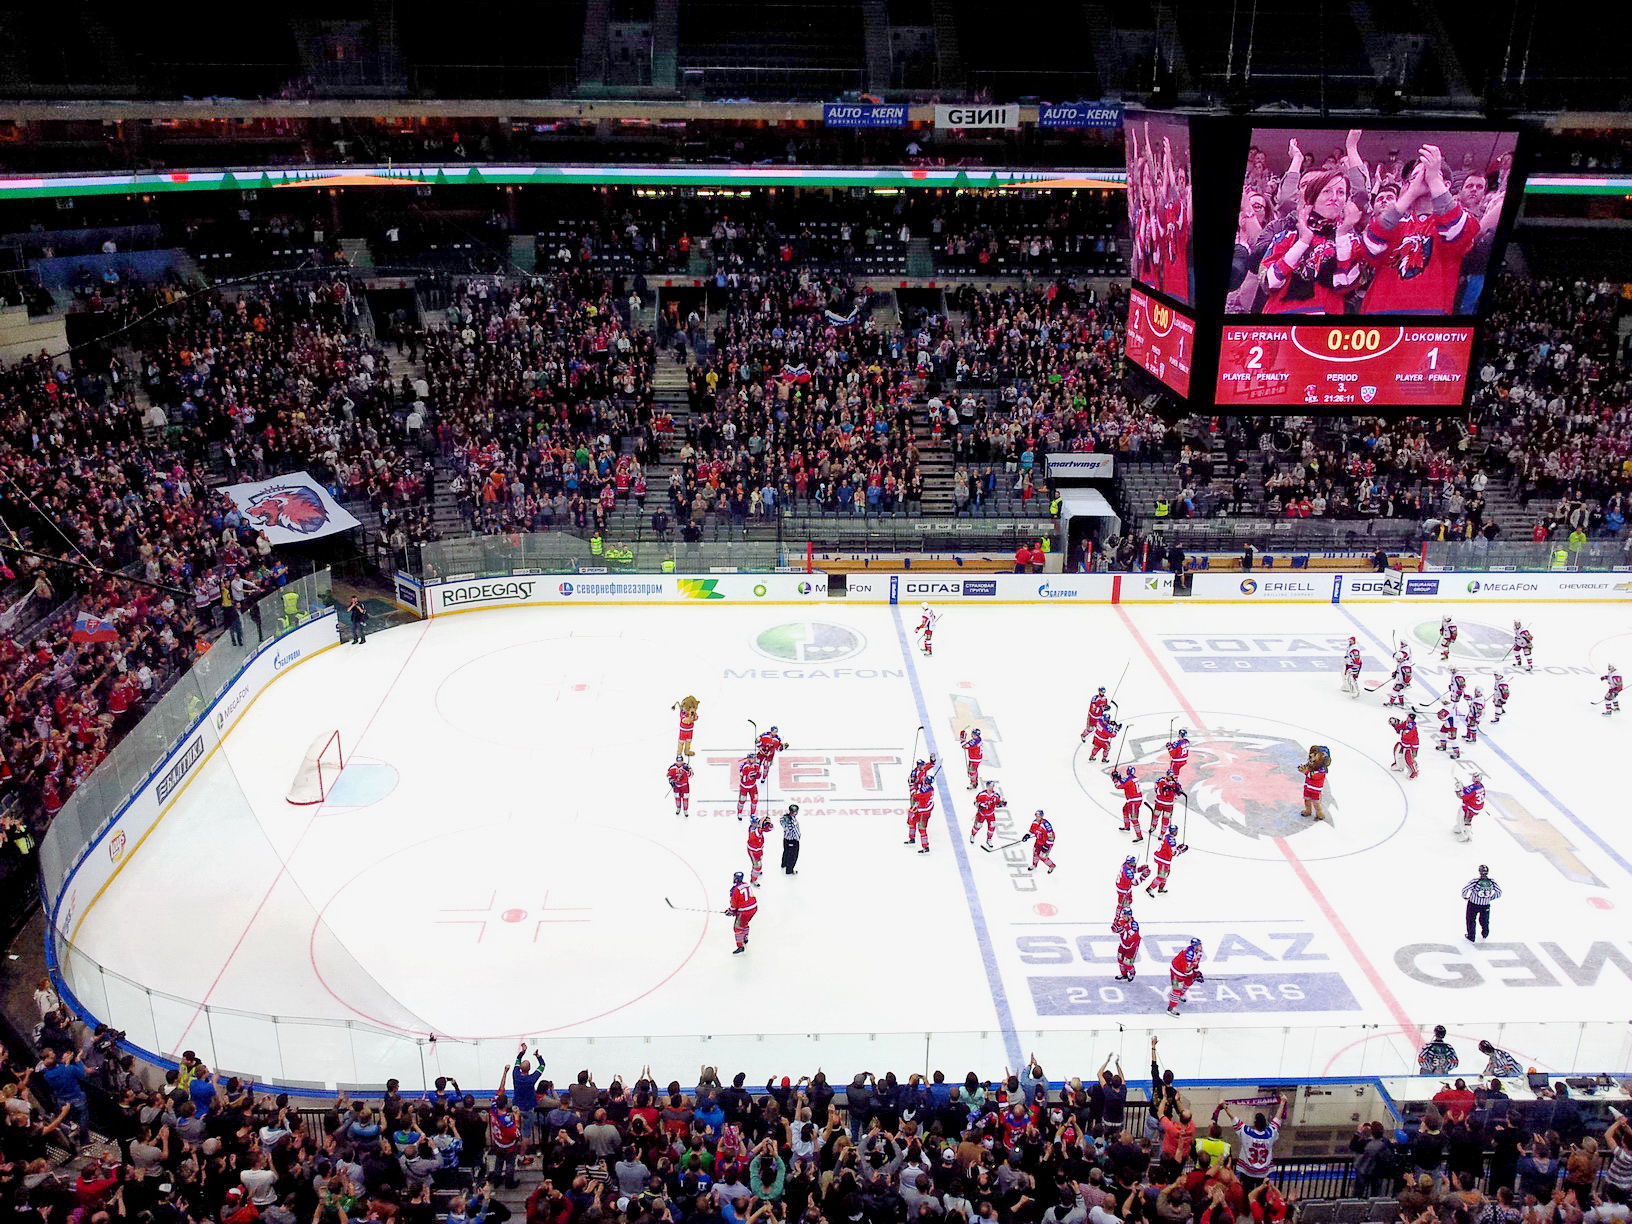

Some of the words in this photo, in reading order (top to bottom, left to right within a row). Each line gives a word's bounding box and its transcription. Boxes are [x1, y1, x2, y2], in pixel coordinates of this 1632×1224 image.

[828, 107, 862, 118] AUTO
[871, 107, 904, 118] KERN
[1043, 108, 1077, 119] AUTO
[1086, 109, 1119, 120] KERN
[1133, 308, 1140, 330] 2
[1153, 304, 1169, 329] 0:00
[1227, 332, 1249, 341] LEV
[1251, 332, 1288, 341] PRAHA
[1327, 329, 1380, 350] 0:00
[1404, 333, 1468, 342] LOKOMOTIV
[1179, 336, 1185, 358] 1
[1246, 346, 1264, 369] 2
[1427, 347, 1439, 370] 1
[1222, 373, 1251, 381] PLAYER
[1256, 373, 1290, 381] PENALTY
[1326, 373, 1359, 382] PERIOD
[1395, 374, 1423, 382] PLAYER
[1428, 374, 1461, 382] PENALTY
[1337, 382, 1347, 392] 3.
[815, 585, 872, 593] MFON
[907, 584, 960, 593] СОГАЗ
[1264, 583, 1315, 591] ERIELL
[443, 582, 536, 607] RADEGAST
[1050, 590, 1078, 598] GAZPROM
[723, 668, 905, 679] MEGAFON
[790, 795, 825, 804] ЧАЙ
[803, 808, 908, 817] ХАРАКТЕРО
[1478, 889, 1491, 898] 63
[1015, 932, 1331, 965] SOGAZ
[1066, 986, 1124, 1004] 20
[1247, 1147, 1270, 1165] 33
